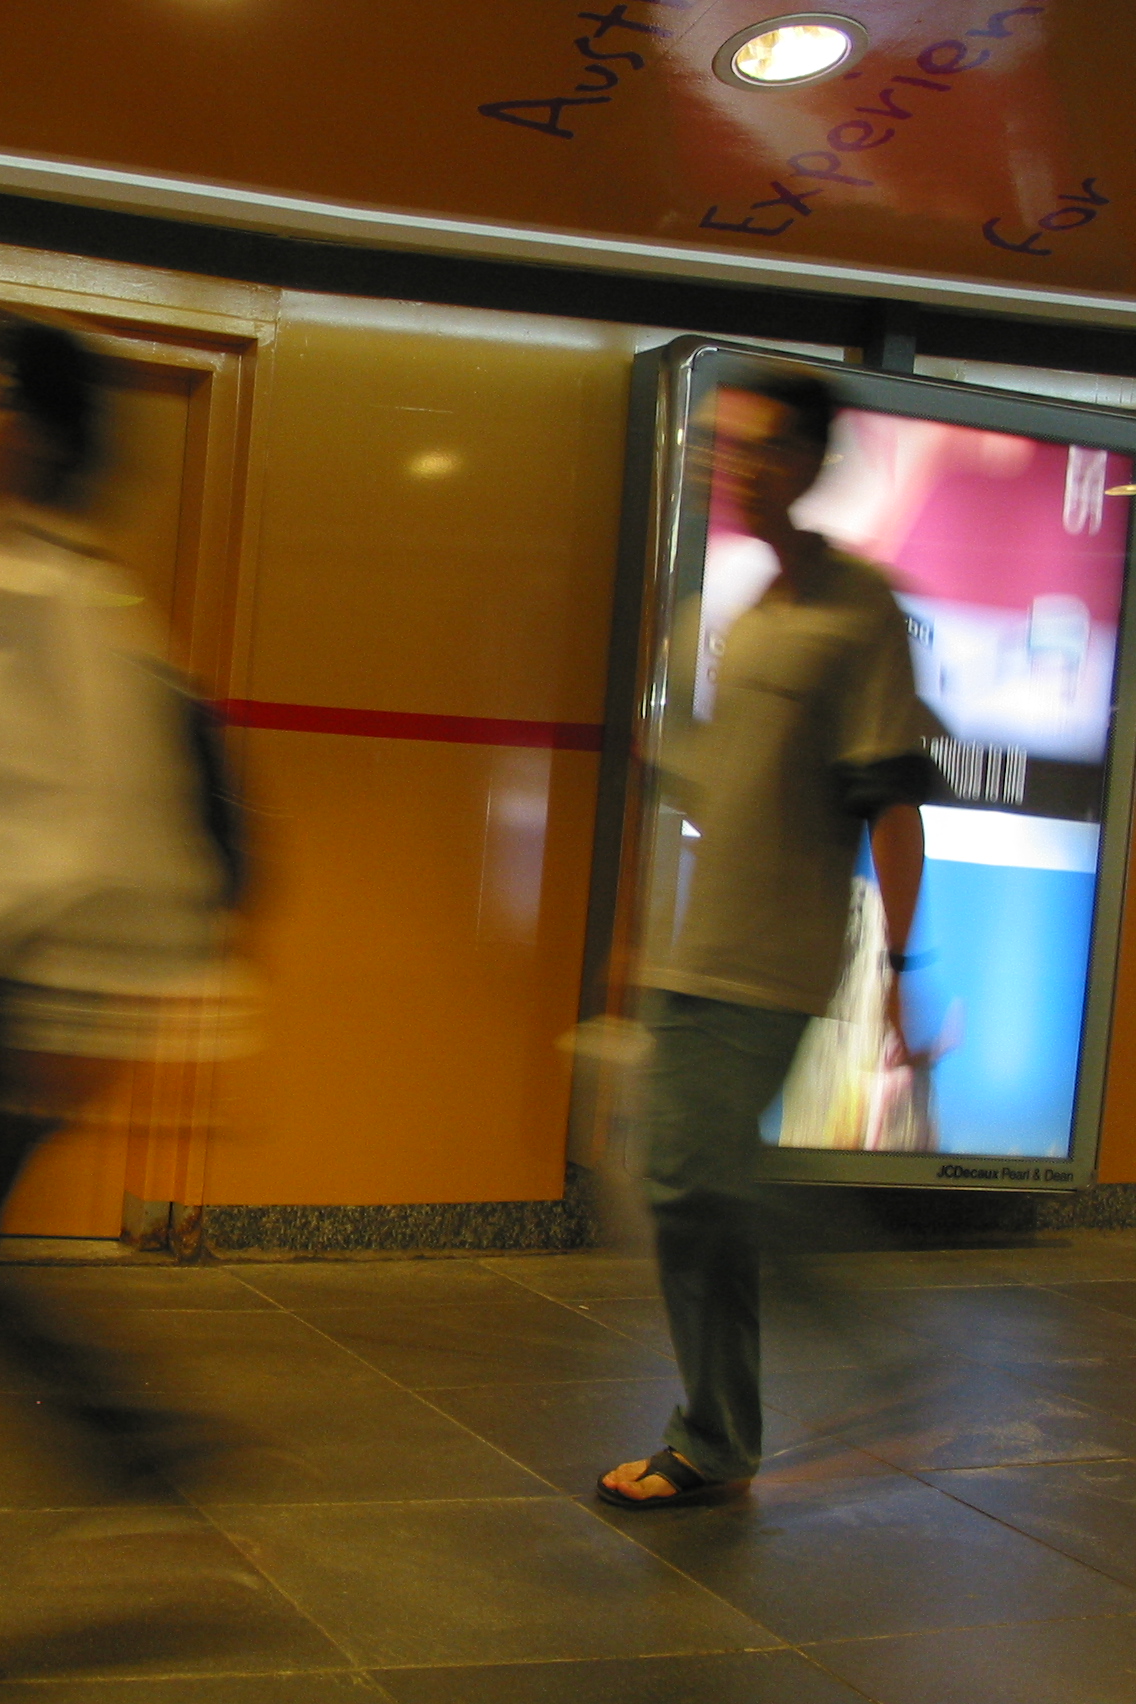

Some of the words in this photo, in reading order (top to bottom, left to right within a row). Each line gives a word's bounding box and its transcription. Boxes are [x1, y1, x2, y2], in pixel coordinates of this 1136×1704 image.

[478, 0, 676, 139] Aust
[698, 0, 1045, 236] Experien
[937, 1164, 999, 1180] JCDecaux
[1002, 1167, 1029, 1181] Pearl
[1033, 1168, 1041, 1181] &
[1044, 1169, 1074, 1182] Dean
